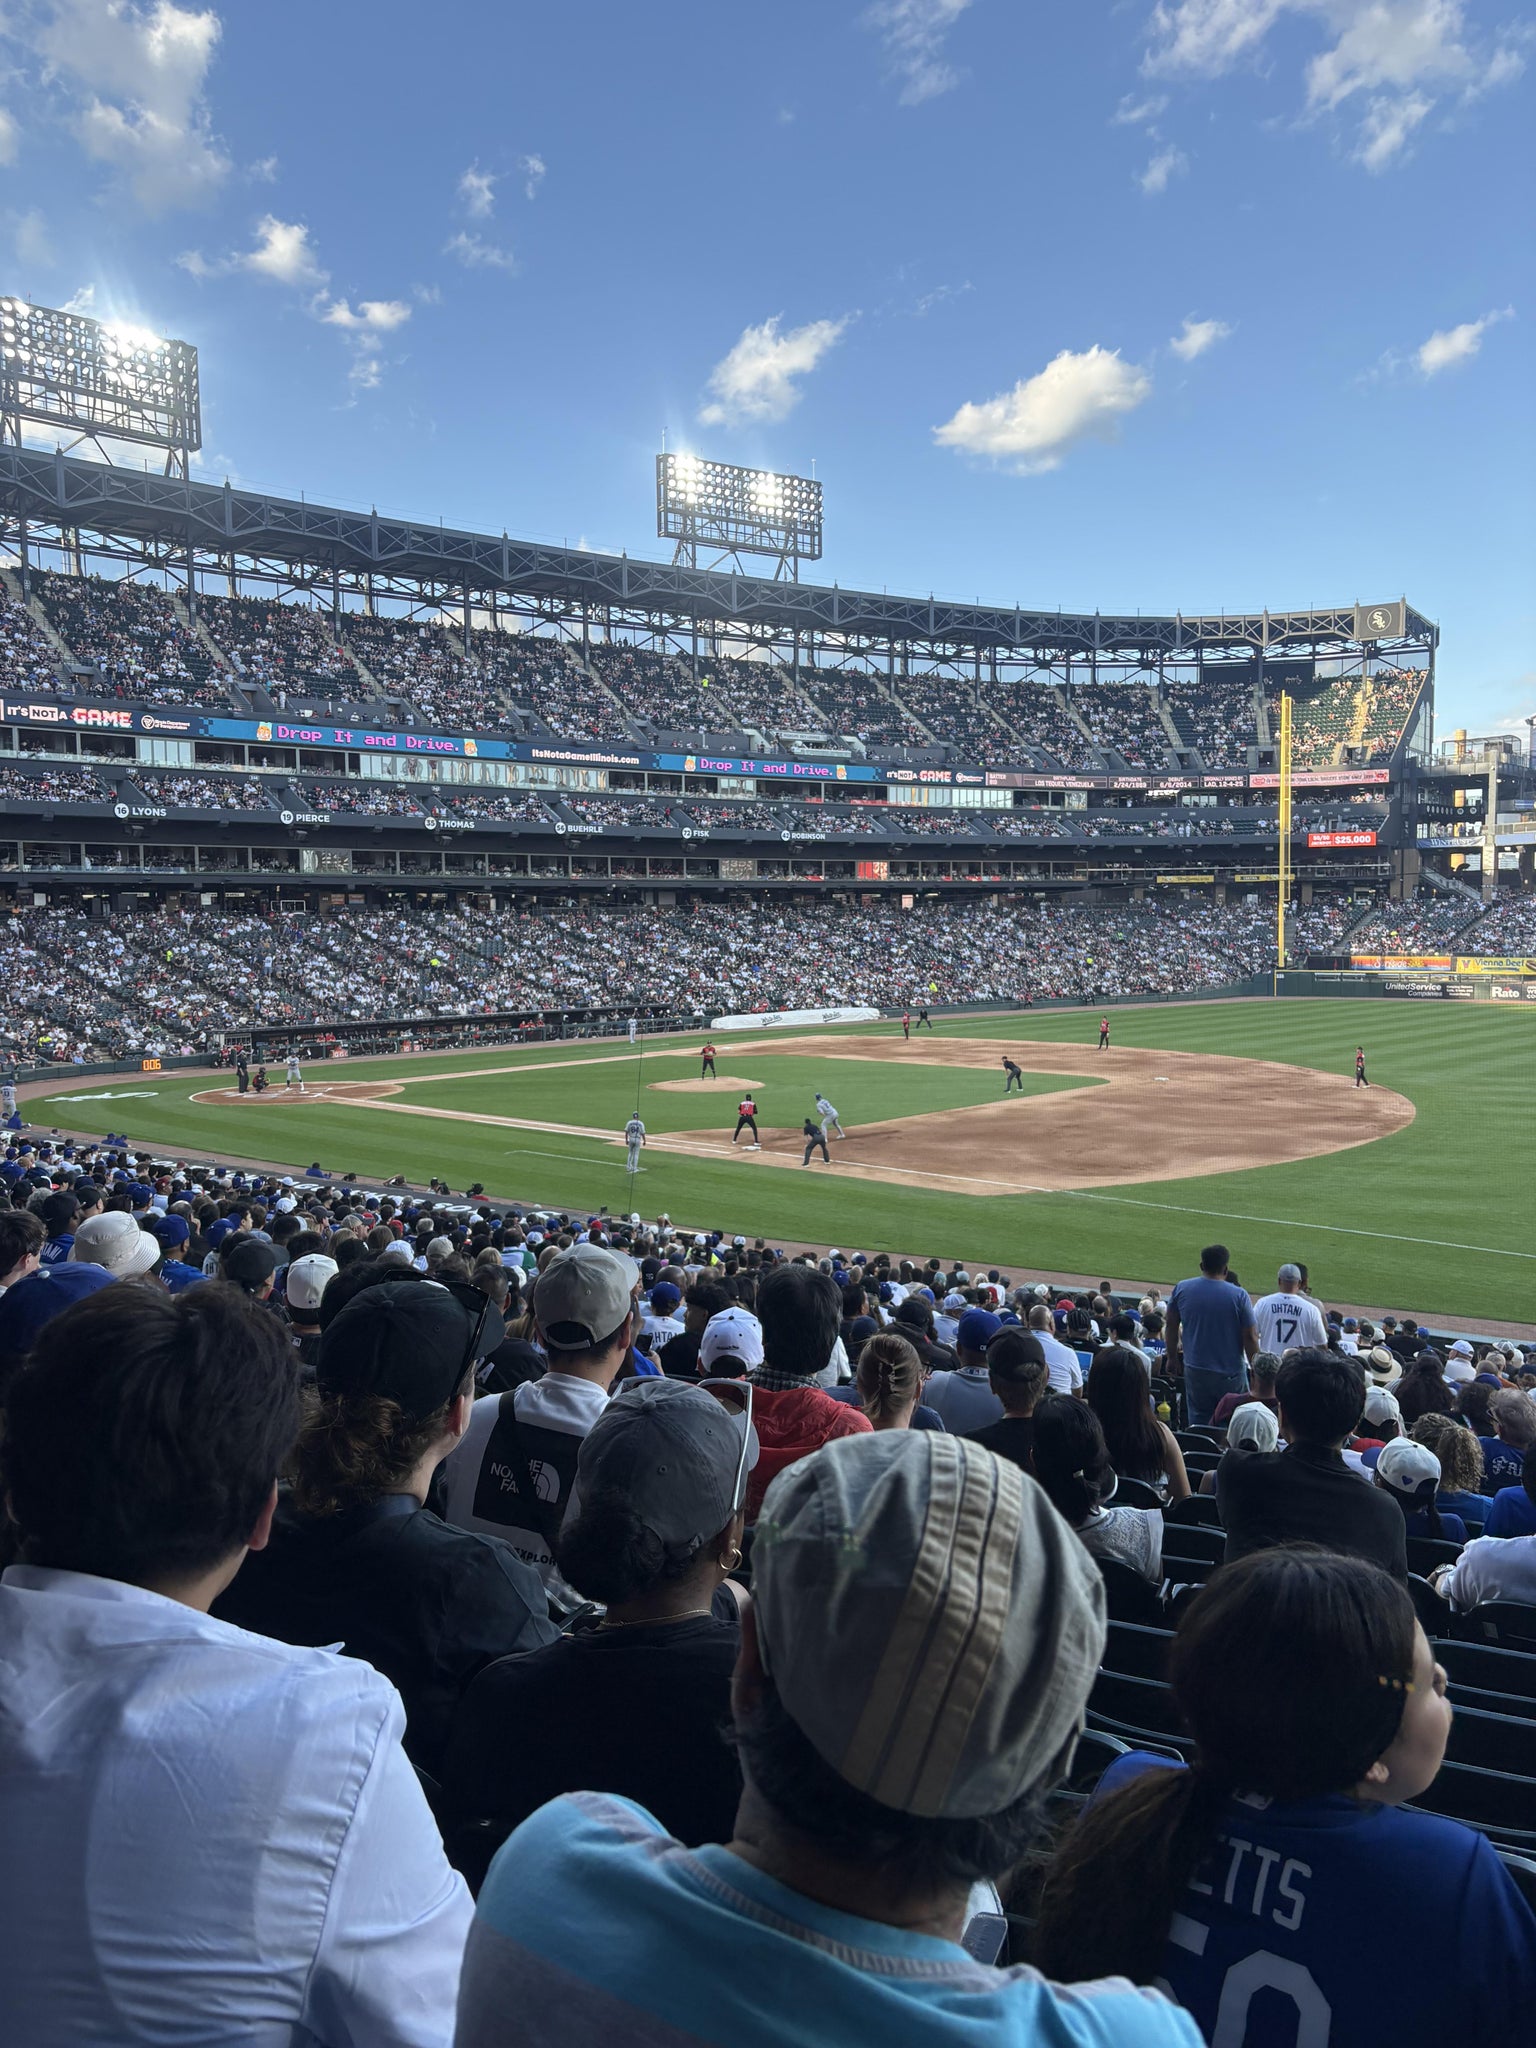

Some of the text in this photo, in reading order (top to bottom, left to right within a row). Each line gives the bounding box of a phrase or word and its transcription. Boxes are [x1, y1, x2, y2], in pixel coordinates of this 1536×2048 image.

[7, 705, 133, 729] IT'S NOT A GAME
[277, 725, 460, 752] Drop It and Drive.
[531, 749, 640, 765] ItsNotaGameIllinois.com
[700, 758, 833, 776] Drop It and Drive.
[886, 771, 898, 779] IT'S
[918, 770, 952, 783] GAME
[116, 807, 167, 817] 16 LYONS
[282, 813, 330, 823] 19 PIERCE
[426, 819, 475, 829] 35 THOMAS
[567, 824, 603, 834] BUEHRLE
[693, 830, 710, 838] FISK
[791, 832, 826, 840] ROBINSON
[1335, 835, 1371, 844] $25,000
[1475, 958, 1524, 966] Vienna Beef
[1407, 990, 1443, 998] Companies
[1271, 1304, 1302, 1317] OHTANI
[1275, 1319, 1298, 1343] 17
